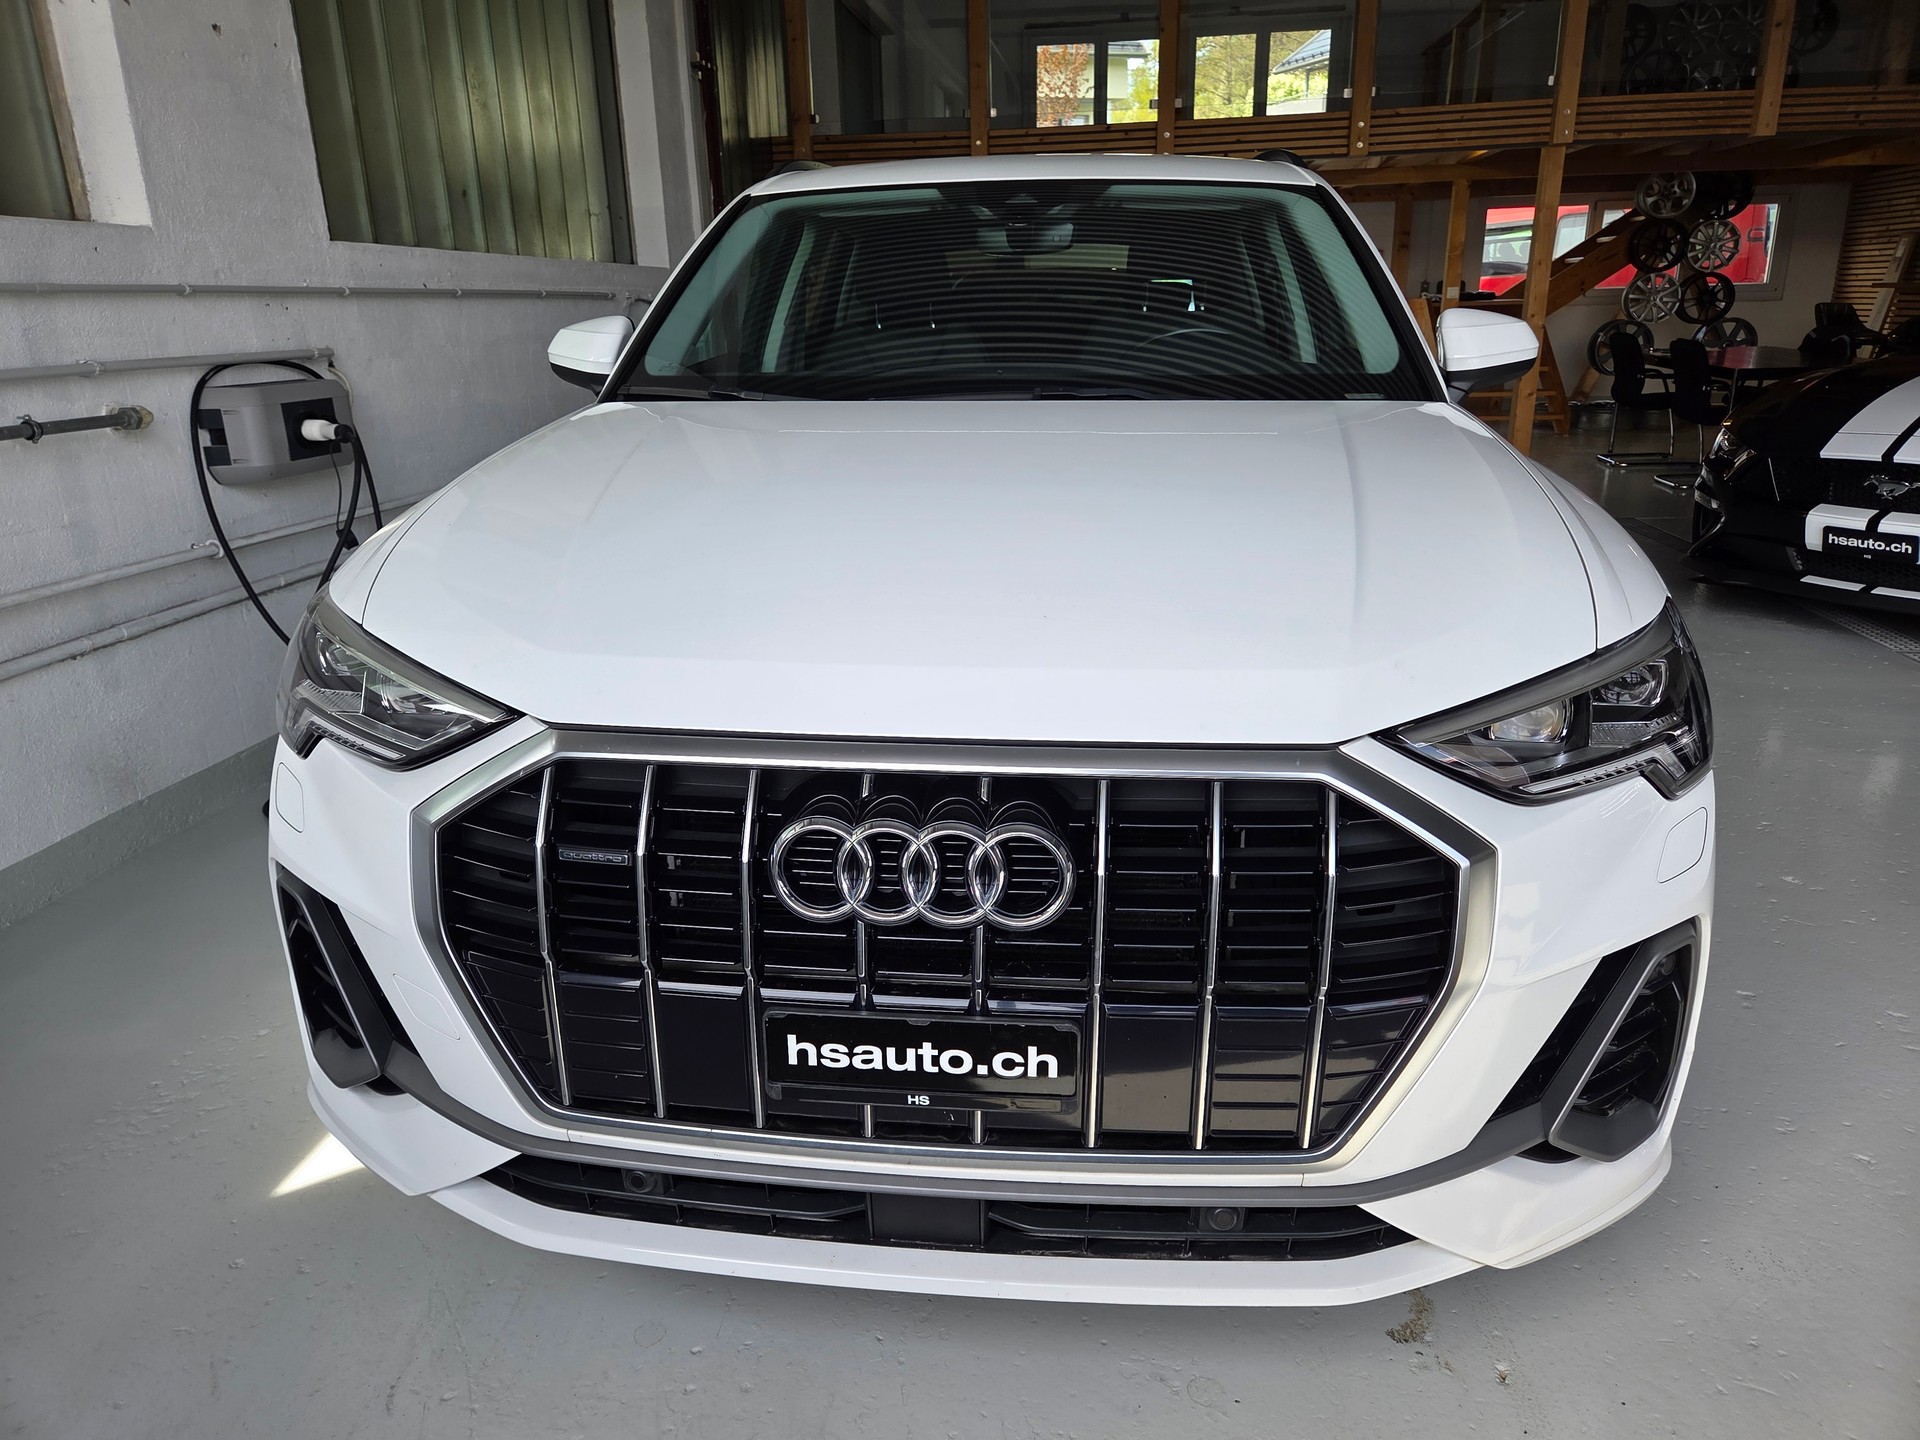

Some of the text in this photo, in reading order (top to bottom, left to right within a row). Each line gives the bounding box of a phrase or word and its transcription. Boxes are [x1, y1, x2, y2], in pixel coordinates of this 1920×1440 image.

[1828, 533, 1913, 554] hsauto.ch
[563, 852, 622, 863] quattro
[787, 1034, 1059, 1079] hsauto.ch
[907, 1095, 931, 1106] HS
